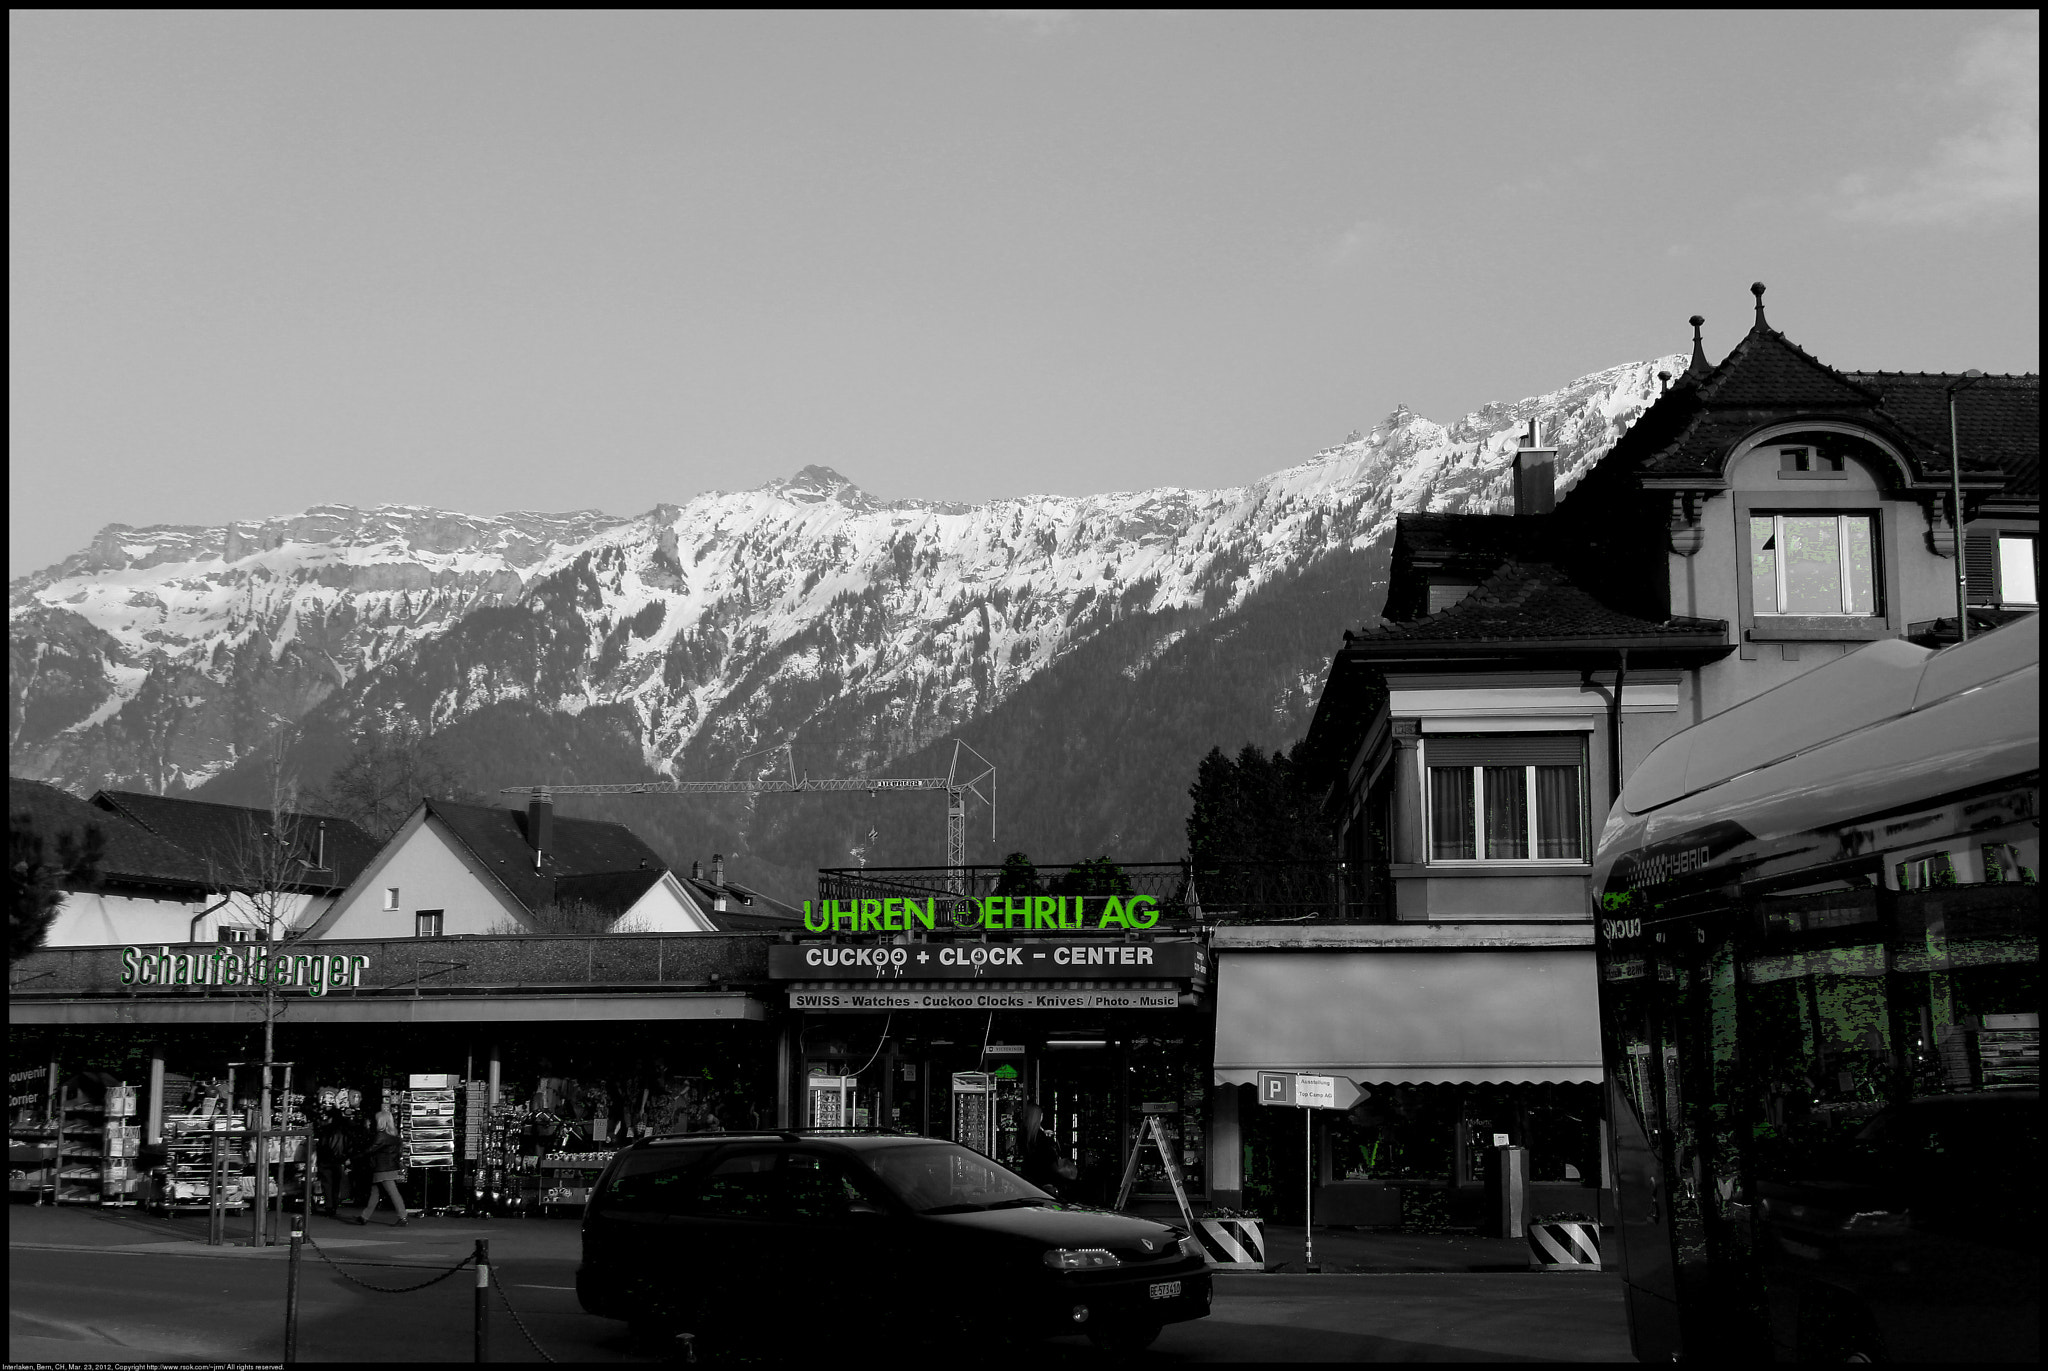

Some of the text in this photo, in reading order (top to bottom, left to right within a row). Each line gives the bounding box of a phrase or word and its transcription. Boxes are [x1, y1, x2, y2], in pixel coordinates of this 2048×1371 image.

[1665, 846, 1709, 876] HYBRID
[803, 897, 935, 932] UHREN
[1098, 894, 1160, 929] AG
[805, 947, 907, 966] CUCKOO
[939, 947, 1023, 966] CLOCK
[1053, 946, 1154, 965] CENTER
[120, 946, 370, 997] Schaufelberger
[796, 995, 840, 1006] SWISS
[852, 994, 910, 1007] Watches
[922, 996, 973, 1006] Cuckoo
[977, 995, 1024, 1006] Clocks
[1036, 996, 1084, 1006] Knives
[1095, 996, 1130, 1006] Photo
[1140, 995, 1175, 1006] Music
[1270, 1080, 1281, 1098] P
